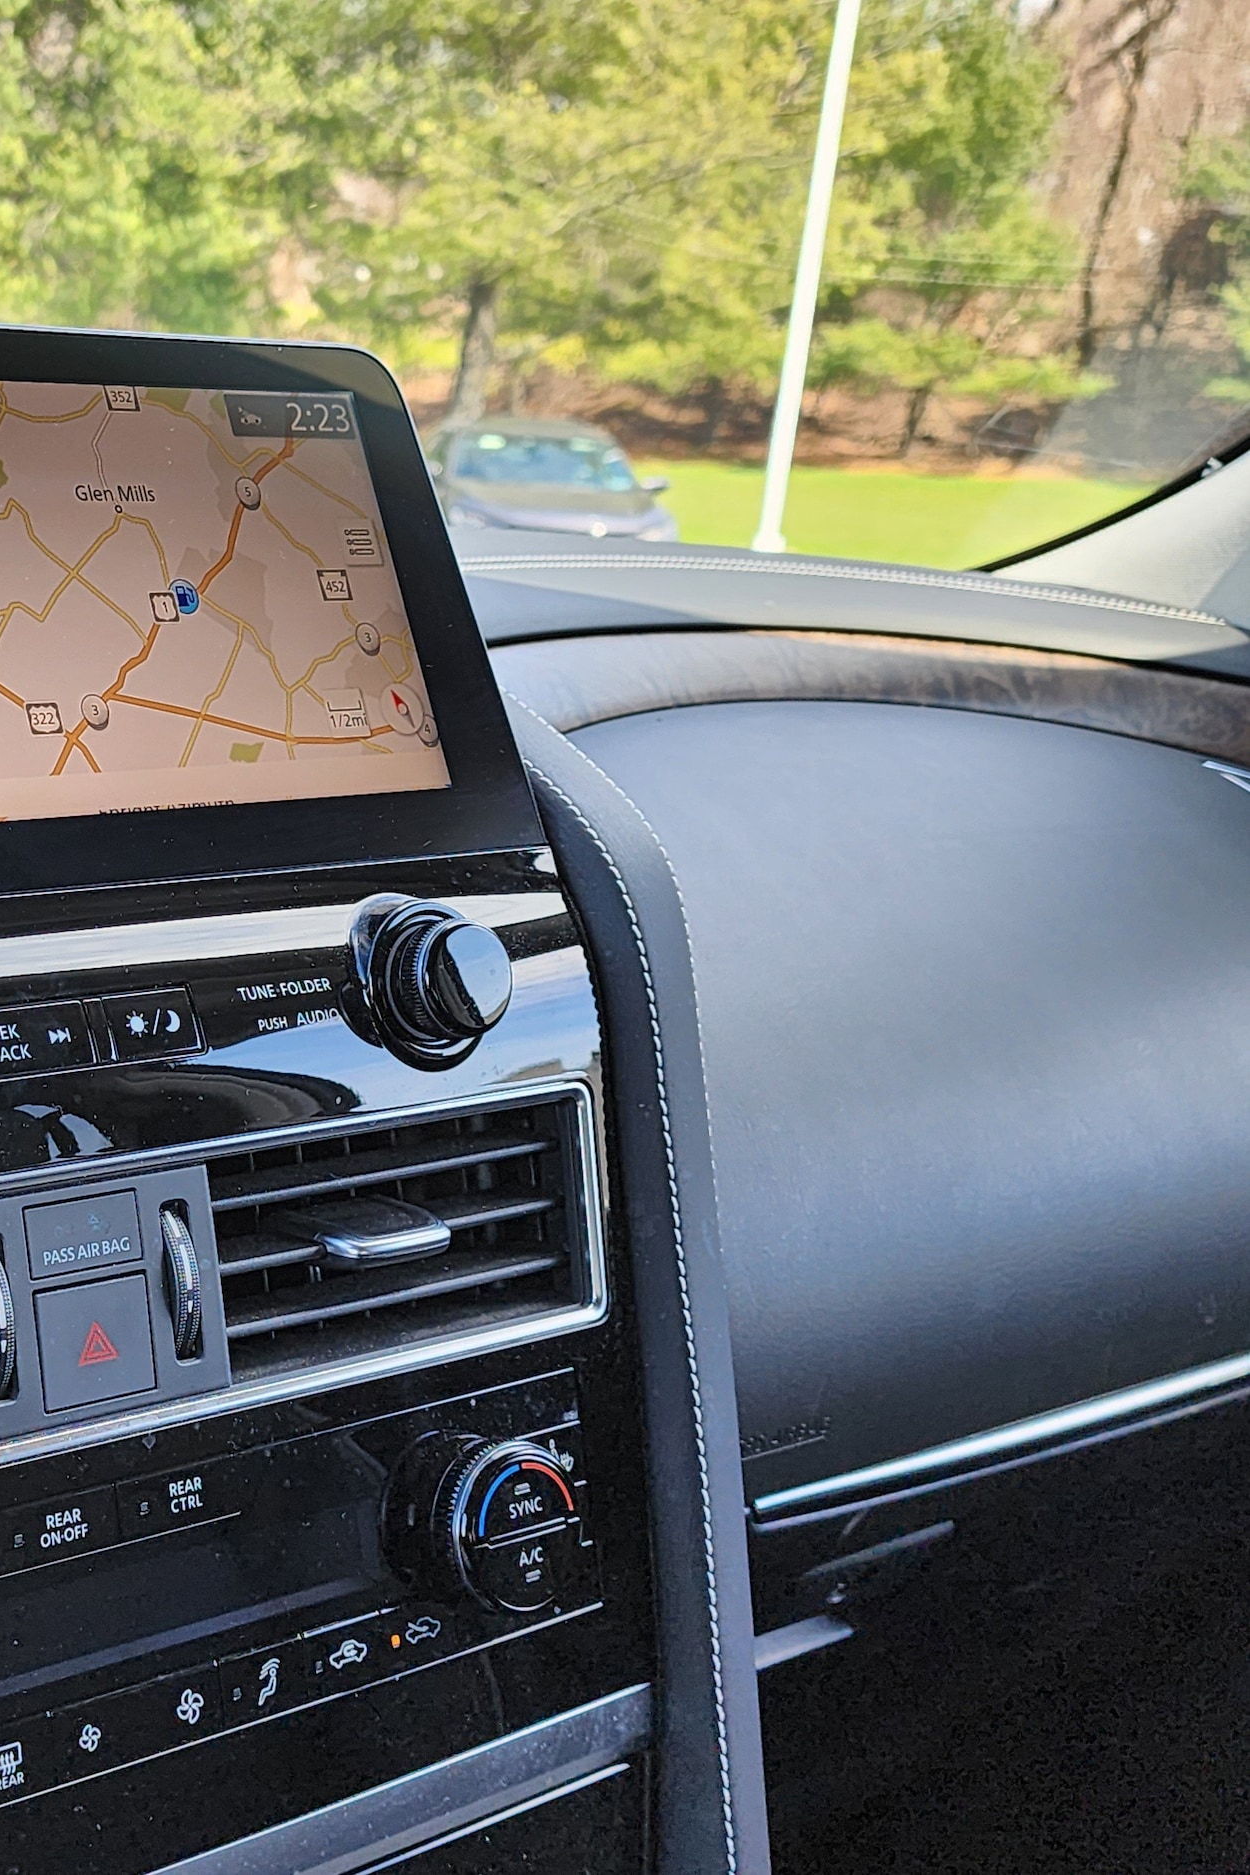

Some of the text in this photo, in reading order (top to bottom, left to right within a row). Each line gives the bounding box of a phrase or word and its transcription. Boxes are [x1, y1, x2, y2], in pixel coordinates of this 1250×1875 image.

[110, 390, 133, 403] 352
[286, 402, 350, 432] 2:23
[75, 485, 156, 502] Glen Mills
[244, 486, 252, 497] 5
[325, 580, 346, 594] 452
[161, 600, 169, 614] 1
[363, 631, 372, 642] 3
[90, 704, 99, 716] 3
[31, 711, 55, 726] 322
[329, 713, 368, 728] 1/2mi
[424, 723, 431, 734] 4
[258, 1007, 340, 1032] PUSH AUDIO
[43, 1236, 131, 1265] PASS AIR BAG
[169, 1476, 202, 1498] REAR
[170, 1493, 203, 1514] CTRL
[508, 1496, 543, 1519] SYNC
[46, 1508, 82, 1530] REAR
[519, 1547, 544, 1567] A/C
